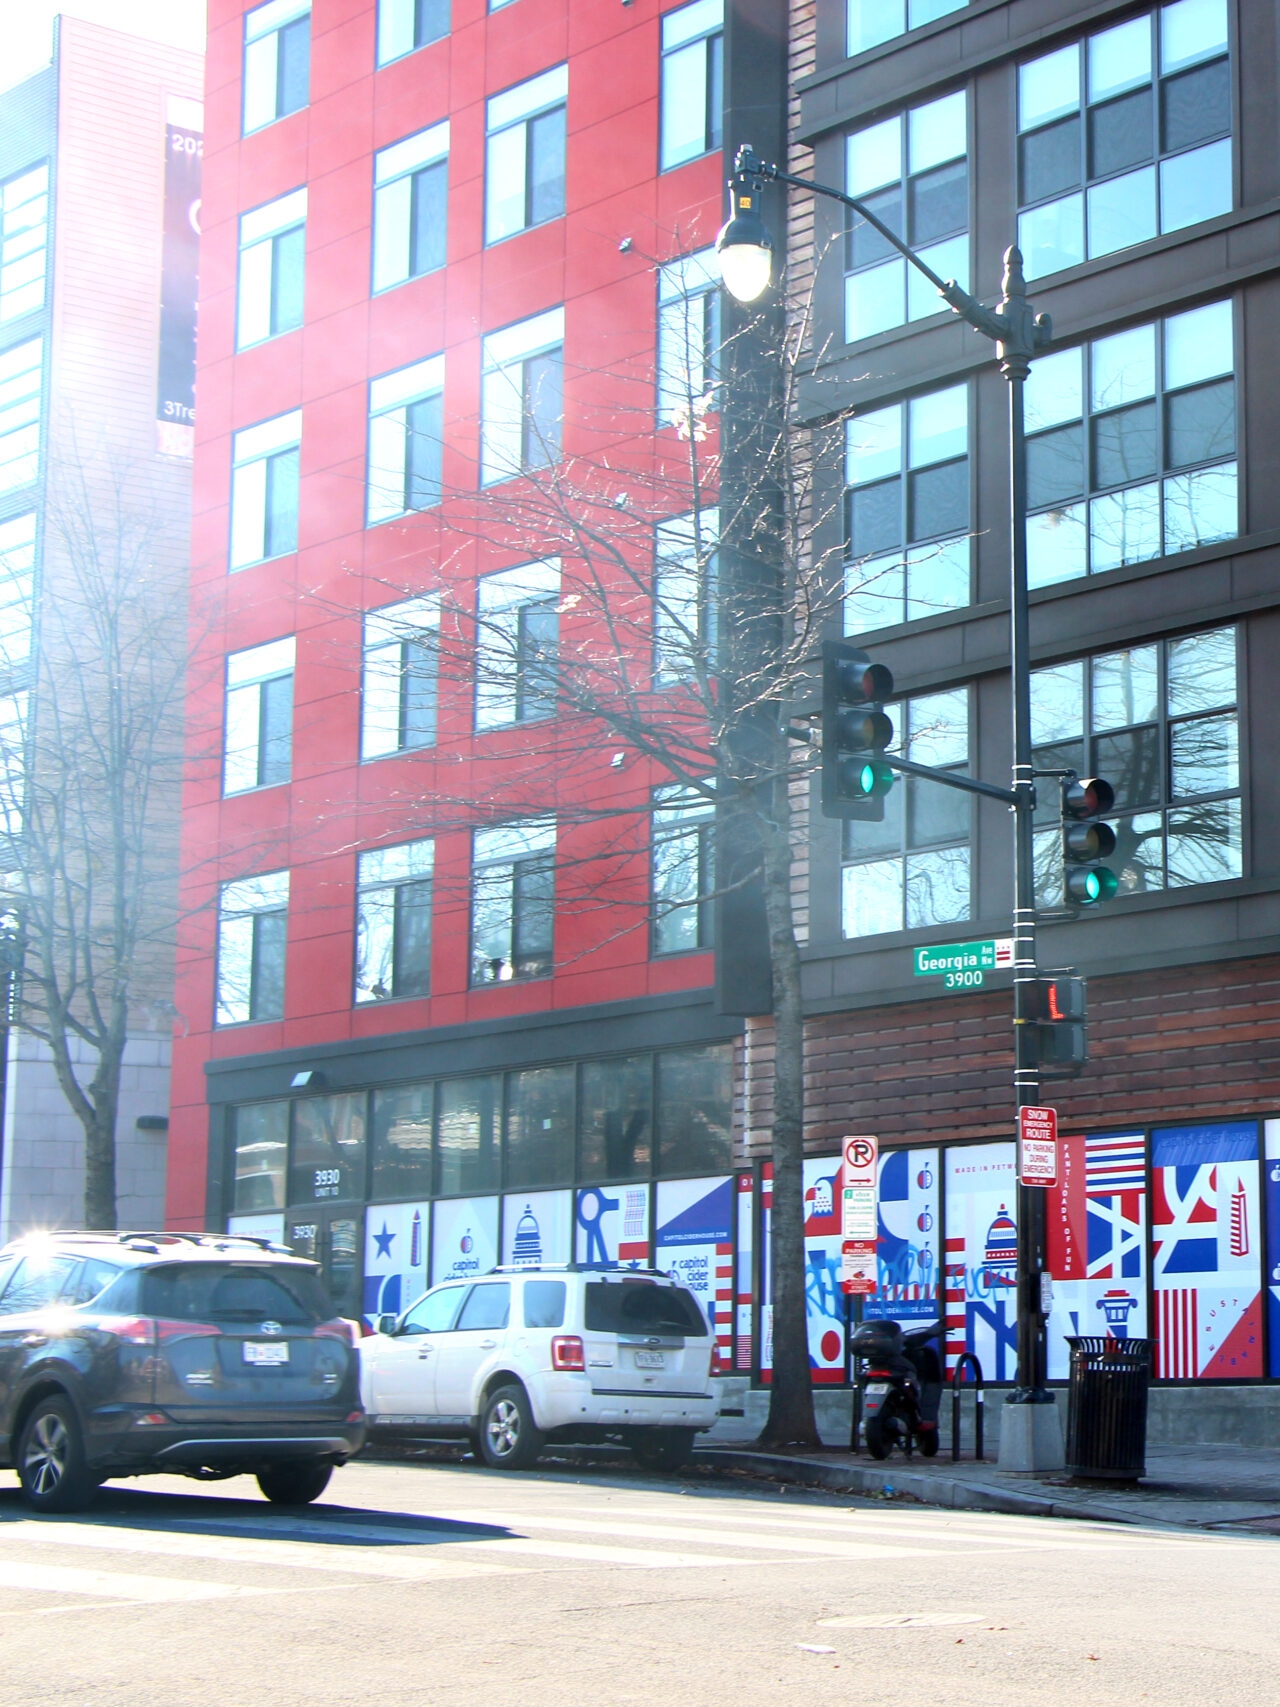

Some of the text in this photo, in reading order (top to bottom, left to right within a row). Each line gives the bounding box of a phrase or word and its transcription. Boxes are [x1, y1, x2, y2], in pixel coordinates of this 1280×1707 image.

[981, 945, 993, 955] Ave
[918, 951, 977, 971] Georgia
[946, 970, 983, 988] 3900
[1027, 1110, 1049, 1120] SNOW
[1023, 1120, 1054, 1128] EMERGENCY
[1025, 1128, 1052, 1139] ROUTE
[1024, 1143, 1055, 1153] NO PARKING
[1029, 1154, 1049, 1163] DURING
[955, 1166, 976, 1174] MADE
[1023, 1164, 1054, 1174] EMERGENCY
[314, 1169, 340, 1186] 3930
[292, 1225, 317, 1239] 3930
[679, 1256, 708, 1271] capitol
[1064, 1248, 1073, 1271] FUN
[687, 1269, 709, 1281] cider
[688, 1281, 709, 1292] ouse
